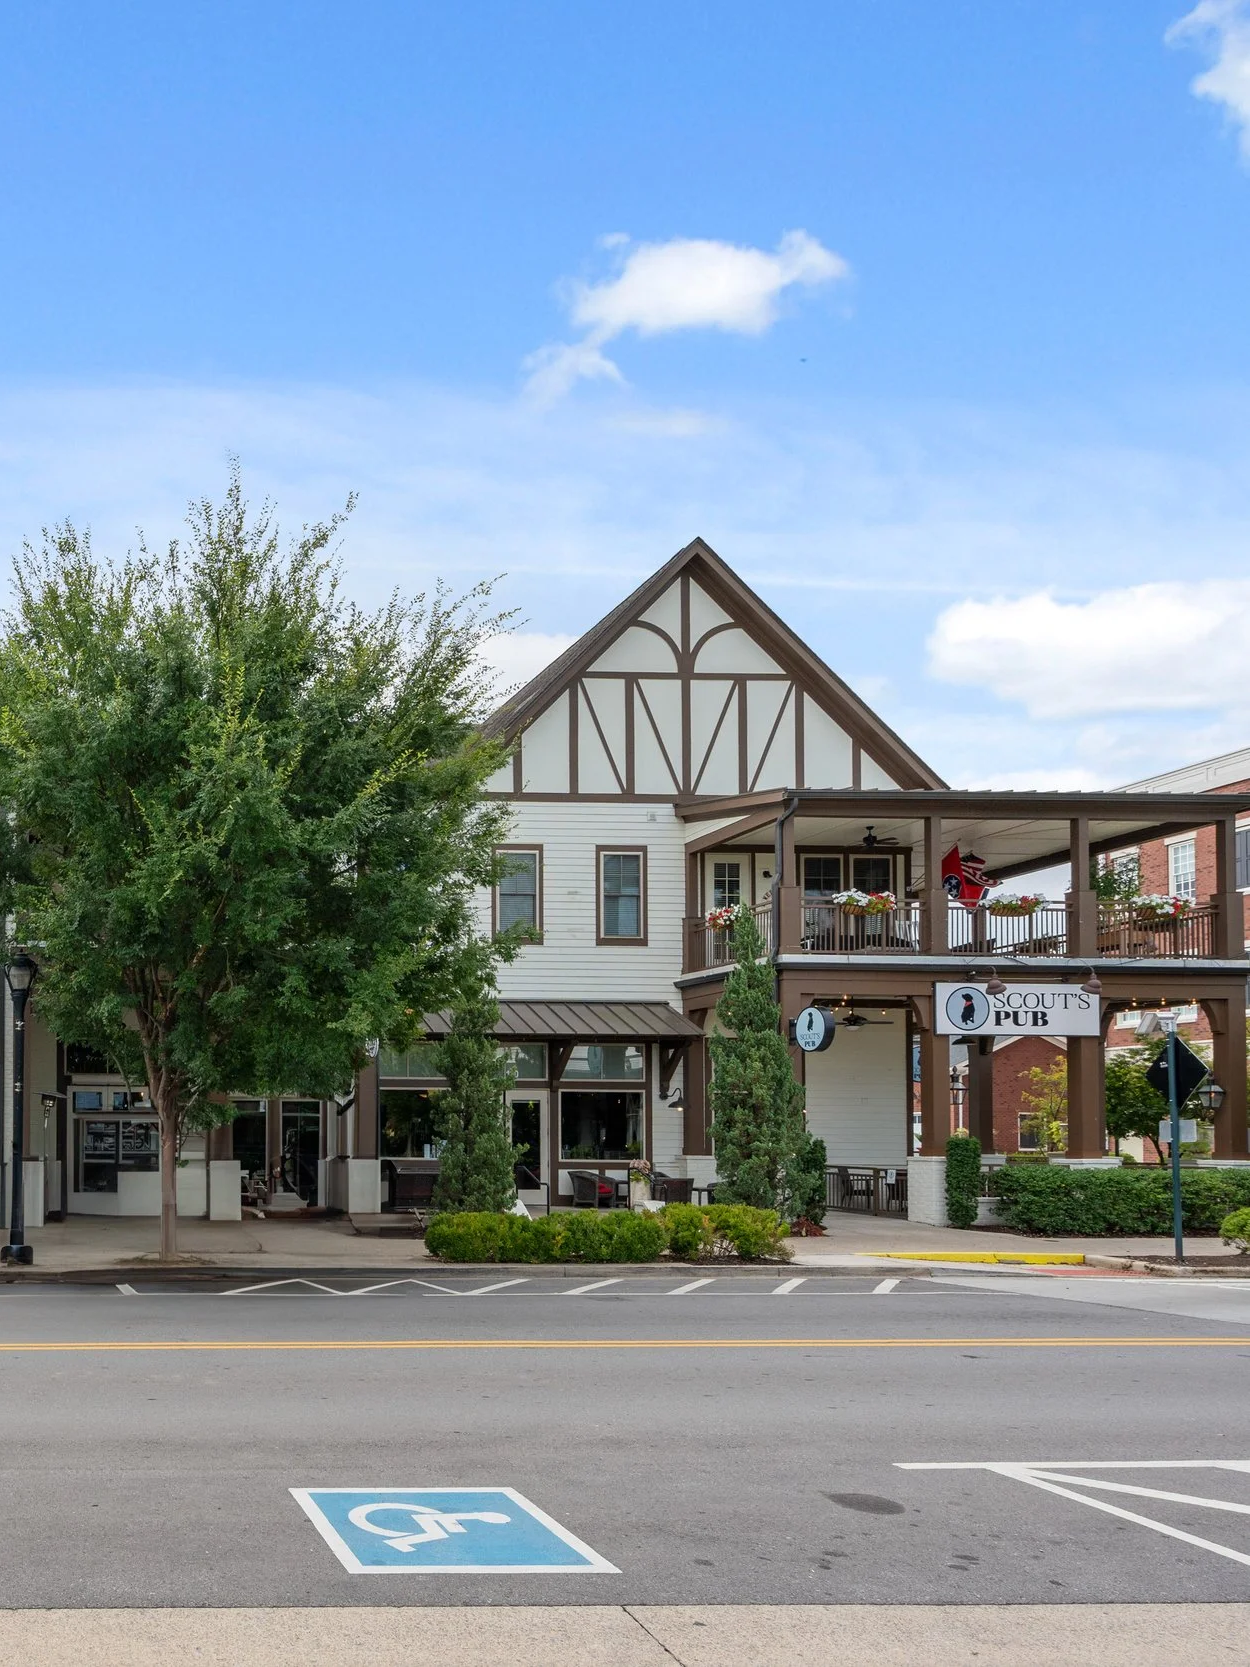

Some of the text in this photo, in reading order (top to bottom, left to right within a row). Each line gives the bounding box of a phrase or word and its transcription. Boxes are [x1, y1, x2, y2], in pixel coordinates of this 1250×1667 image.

[993, 992, 1091, 1010] SCOUT'S
[993, 1010, 1049, 1027] PUB
[804, 1040, 816, 1048] PUB
